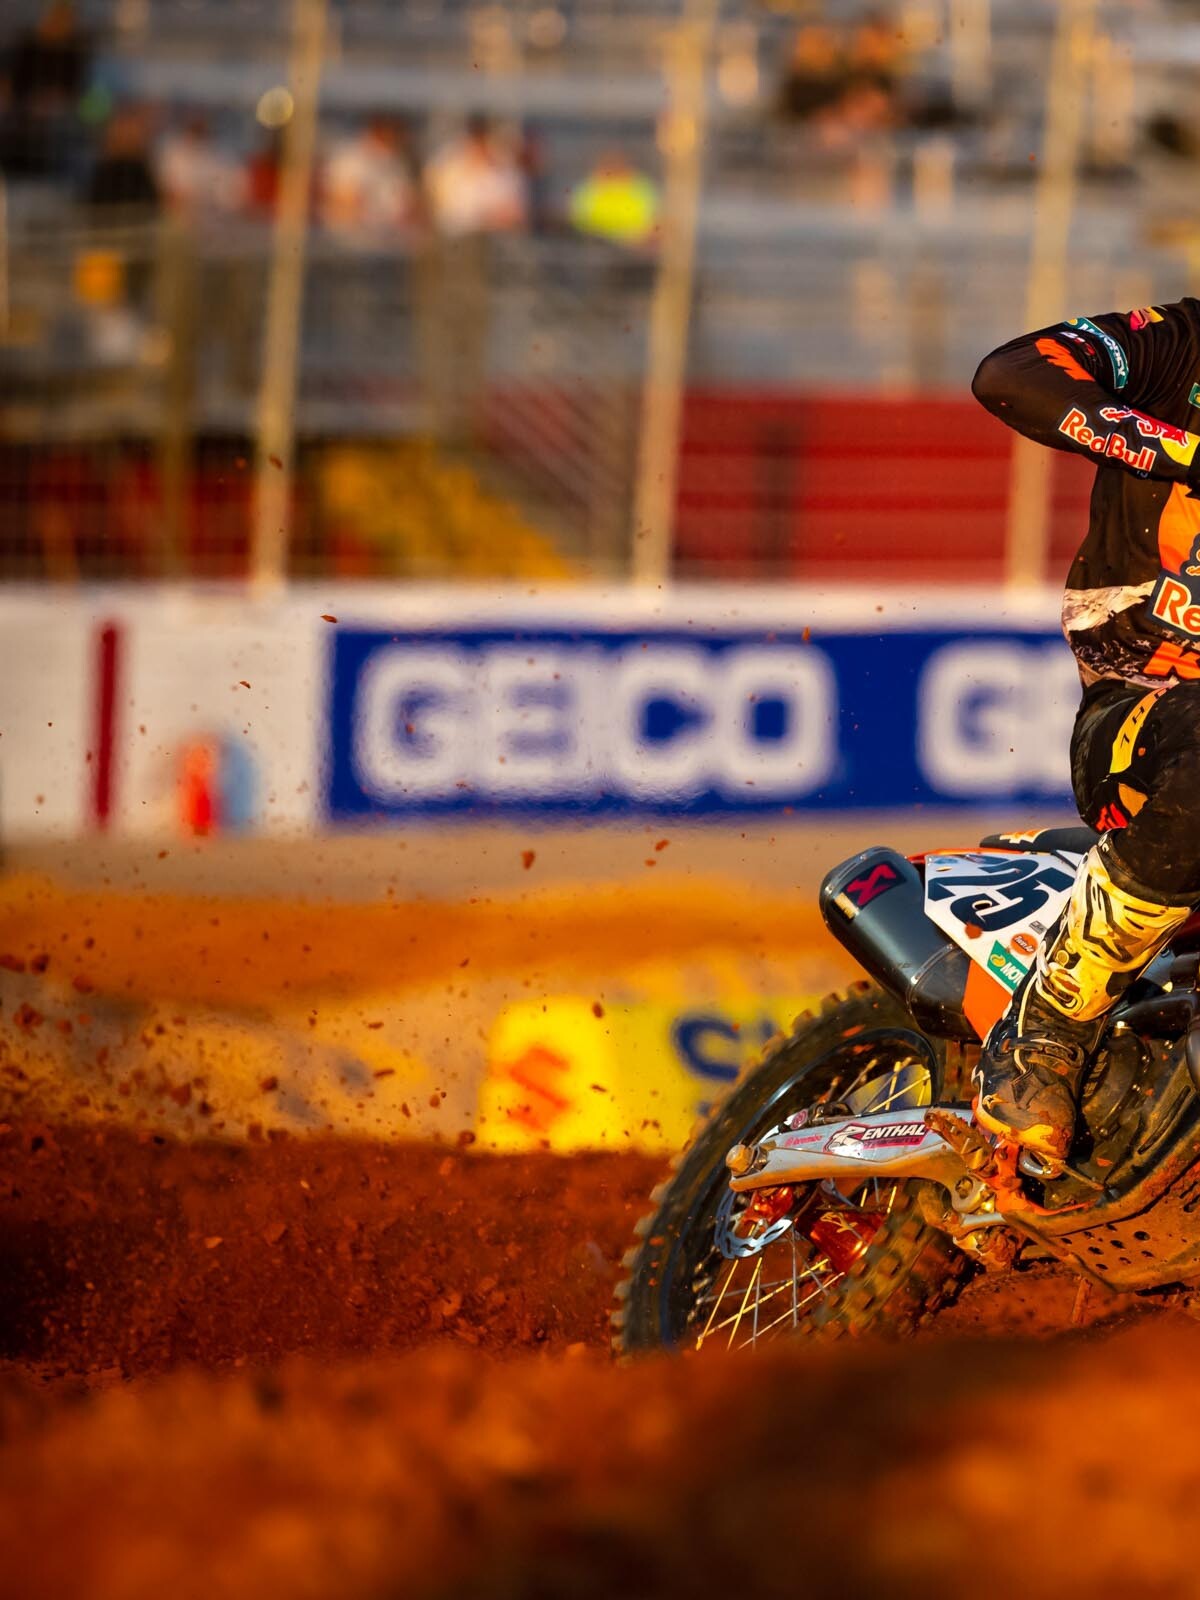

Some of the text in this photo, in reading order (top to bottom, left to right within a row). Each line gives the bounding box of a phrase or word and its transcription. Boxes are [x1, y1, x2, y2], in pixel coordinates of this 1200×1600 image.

[1058, 407, 1157, 472] Red Bull
[345, 640, 836, 800] GEICO
[928, 859, 1076, 932] 25
